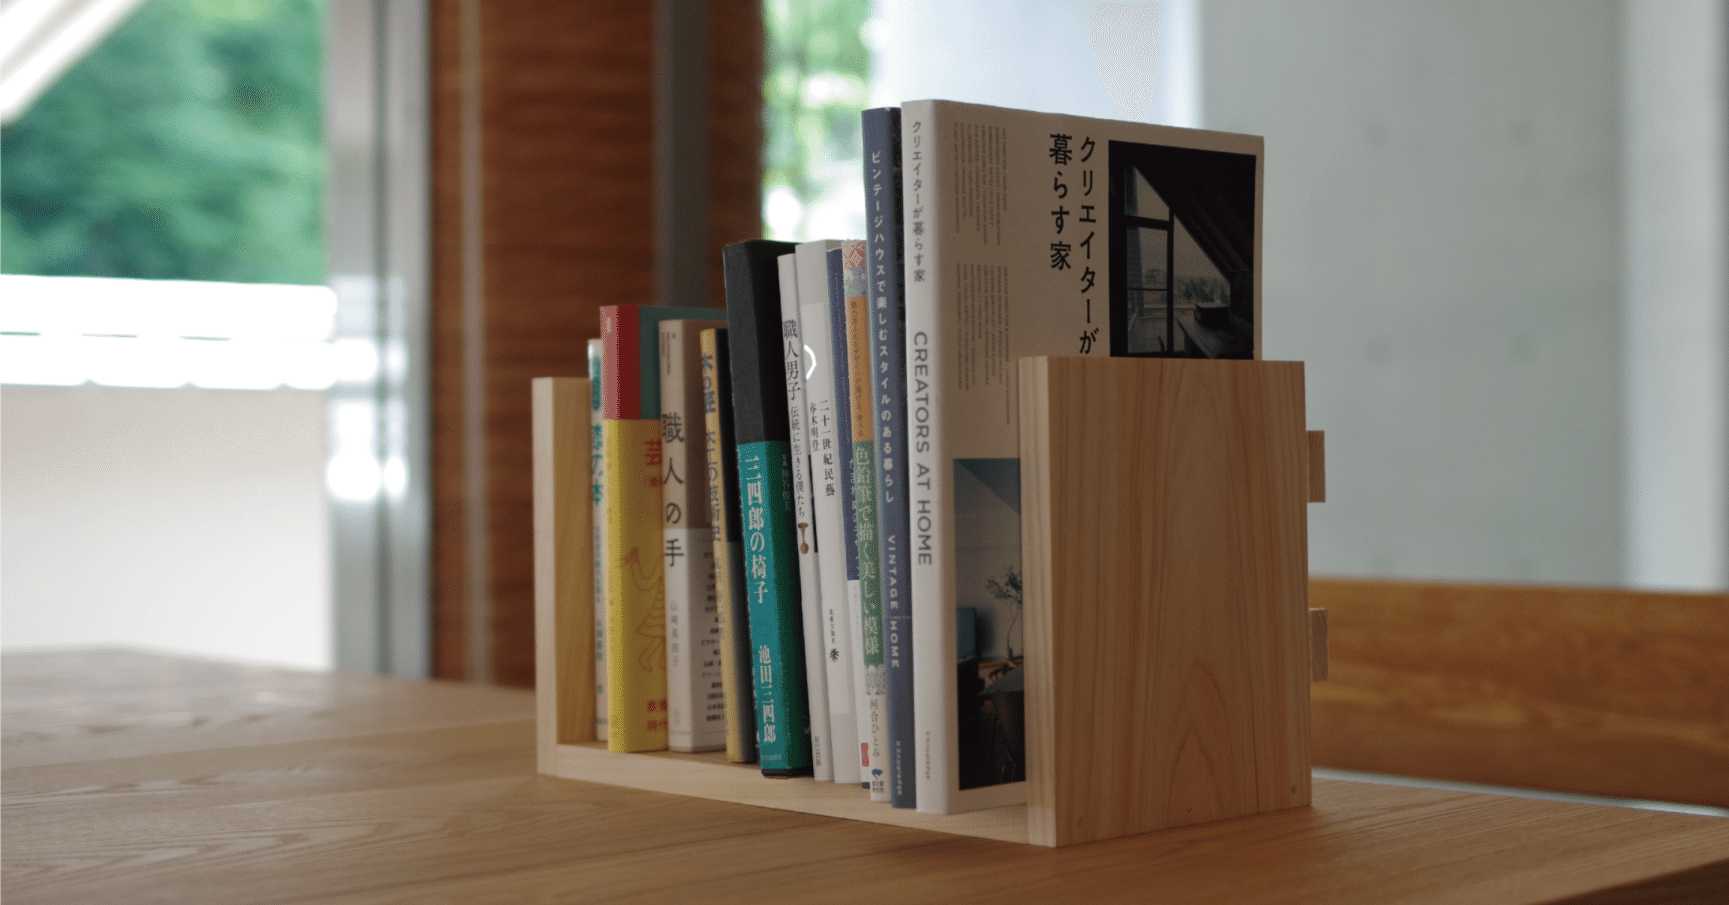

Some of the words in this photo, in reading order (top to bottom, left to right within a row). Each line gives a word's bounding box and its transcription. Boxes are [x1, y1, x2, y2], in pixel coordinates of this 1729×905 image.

[912, 121, 926, 283] クリエイターが暮らす家
[1049, 133, 1073, 271] 暮らす家
[1079, 136, 1099, 355] クリエイターが
[782, 318, 801, 401] 職人男子
[871, 150, 895, 503] ビンテージハウスで楽しむスタイルのある暮らし
[819, 400, 835, 497] 二十一世紀民藝
[913, 331, 930, 453] CREATORS
[661, 412, 685, 567] 職人の手
[745, 456, 769, 604] 三四郎の椅子
[917, 463, 931, 490] AT
[917, 500, 932, 566] HOME
[856, 447, 879, 656] 色鉛筆で描く美しい模様
[887, 534, 899, 610] VINTAGE
[758, 645, 776, 744] 池田三四郎
[890, 620, 900, 668] HOME
